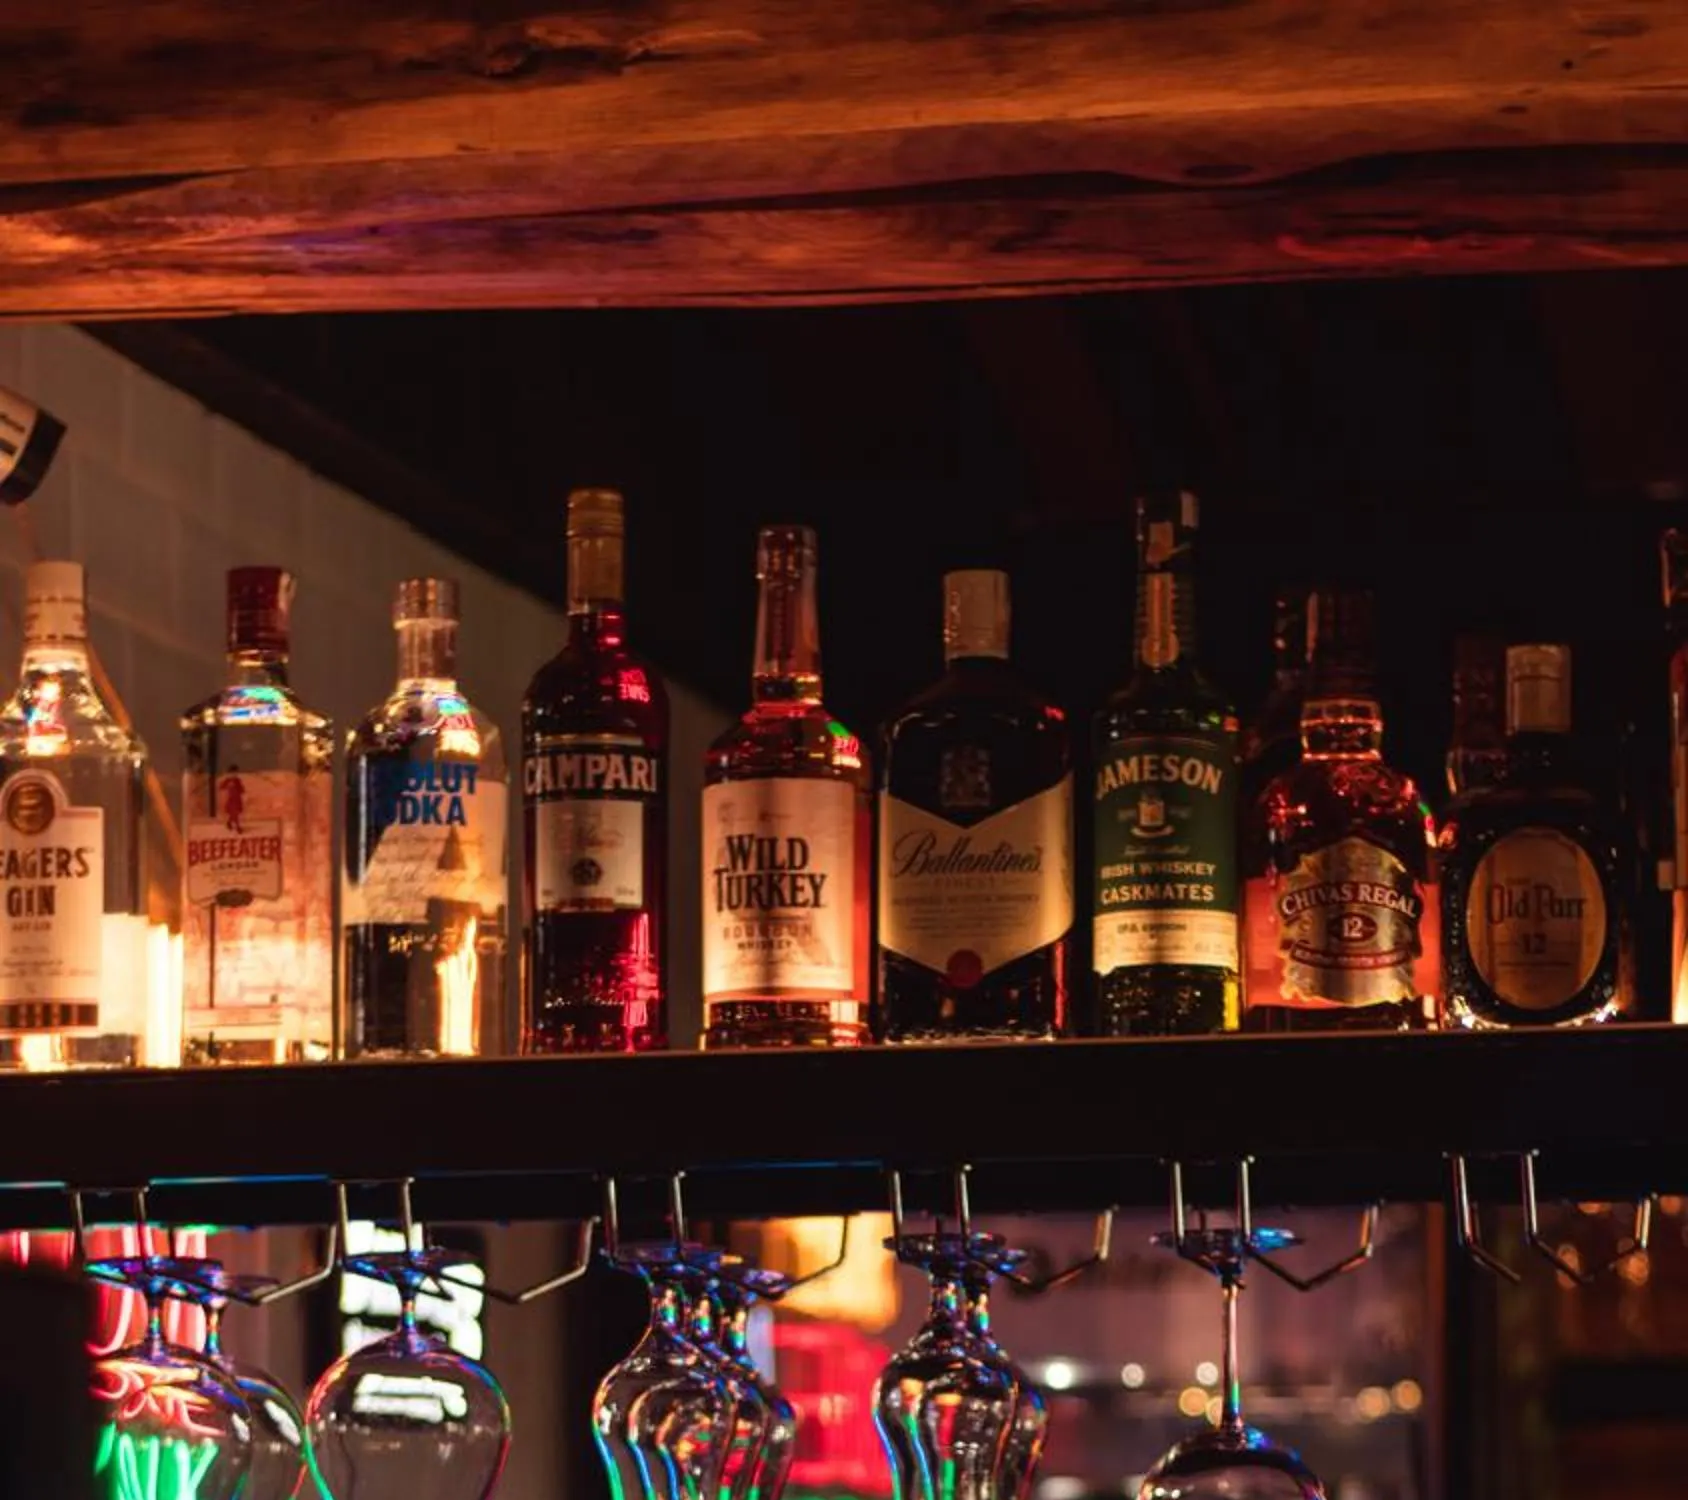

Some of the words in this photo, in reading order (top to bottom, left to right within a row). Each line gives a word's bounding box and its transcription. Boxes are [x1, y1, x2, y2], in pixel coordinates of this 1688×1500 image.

[523, 754, 657, 794] CAMPARI
[1096, 754, 1224, 800] JAMESON
[187, 836, 282, 867] BEEFEATER
[726, 834, 809, 873] WILD
[1101, 863, 1135, 879] IRISH
[1139, 861, 1217, 876] WHISKEY
[7, 884, 56, 918] GIN
[714, 868, 828, 912] TURKEY
[1102, 883, 1216, 905] CASKMATES
[1281, 884, 1354, 916] CHIVAS
[1357, 883, 1417, 918] REGAL
[1487, 882, 1530, 925] Old
[1531, 882, 1589, 923] Parr
[1341, 917, 1365, 938] 12
